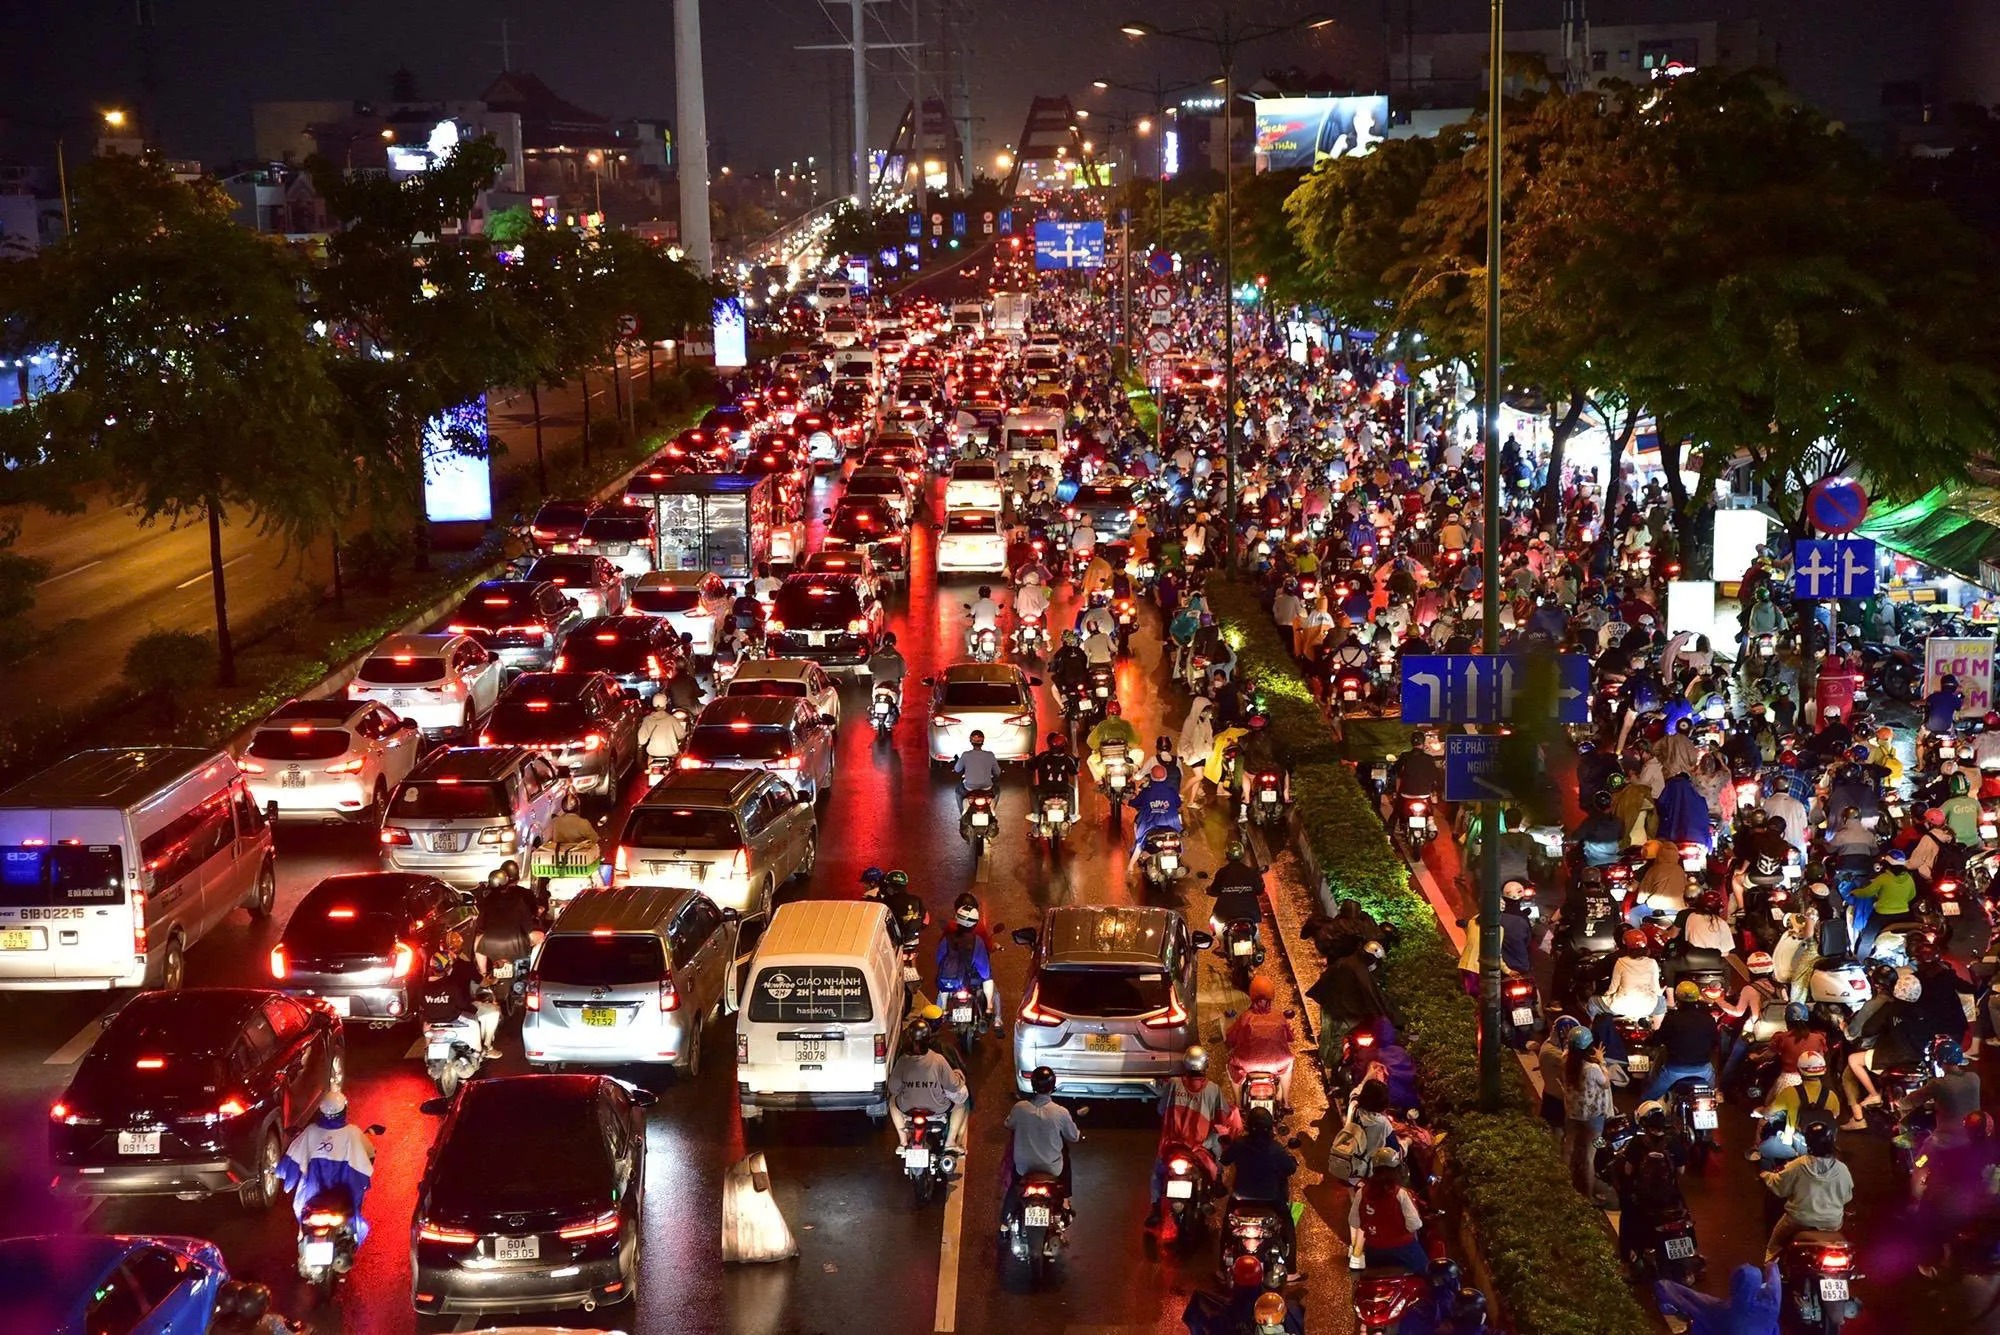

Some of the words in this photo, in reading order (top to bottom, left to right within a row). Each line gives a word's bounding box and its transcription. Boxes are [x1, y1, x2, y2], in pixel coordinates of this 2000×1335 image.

[796, 978, 821, 986] GIAO
[824, 978, 861, 986] NHANH
[818, 985, 843, 996] MIỄN
[844, 987, 861, 996] PHÍ
[803, 1042, 820, 1051] 51D
[131, 1134, 147, 1143] 51K
[123, 1144, 155, 1153] 091.13
[507, 1240, 526, 1249] 60A
[500, 1249, 535, 1259] 863.05
